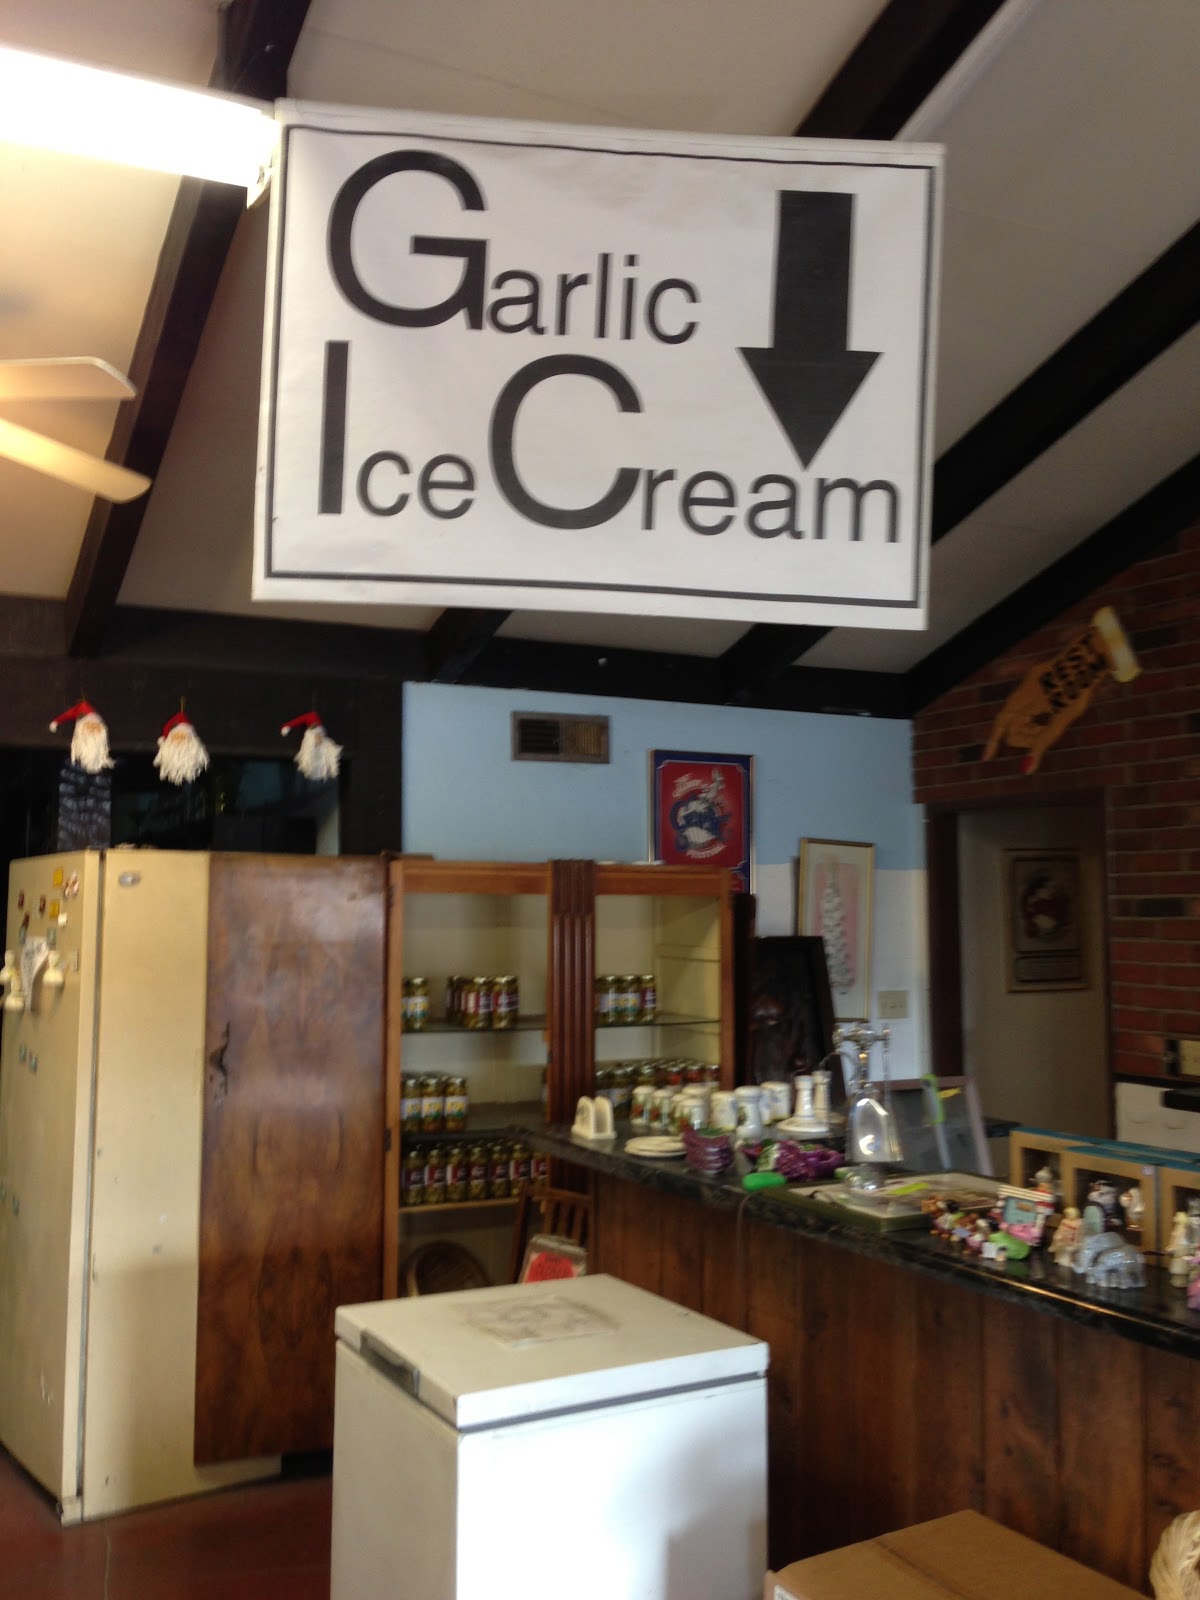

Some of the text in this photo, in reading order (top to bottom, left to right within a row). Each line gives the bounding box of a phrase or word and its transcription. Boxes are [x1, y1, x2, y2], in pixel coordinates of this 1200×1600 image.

[326, 148, 701, 345] Garlic
[316, 340, 901, 543] Ice Cream
